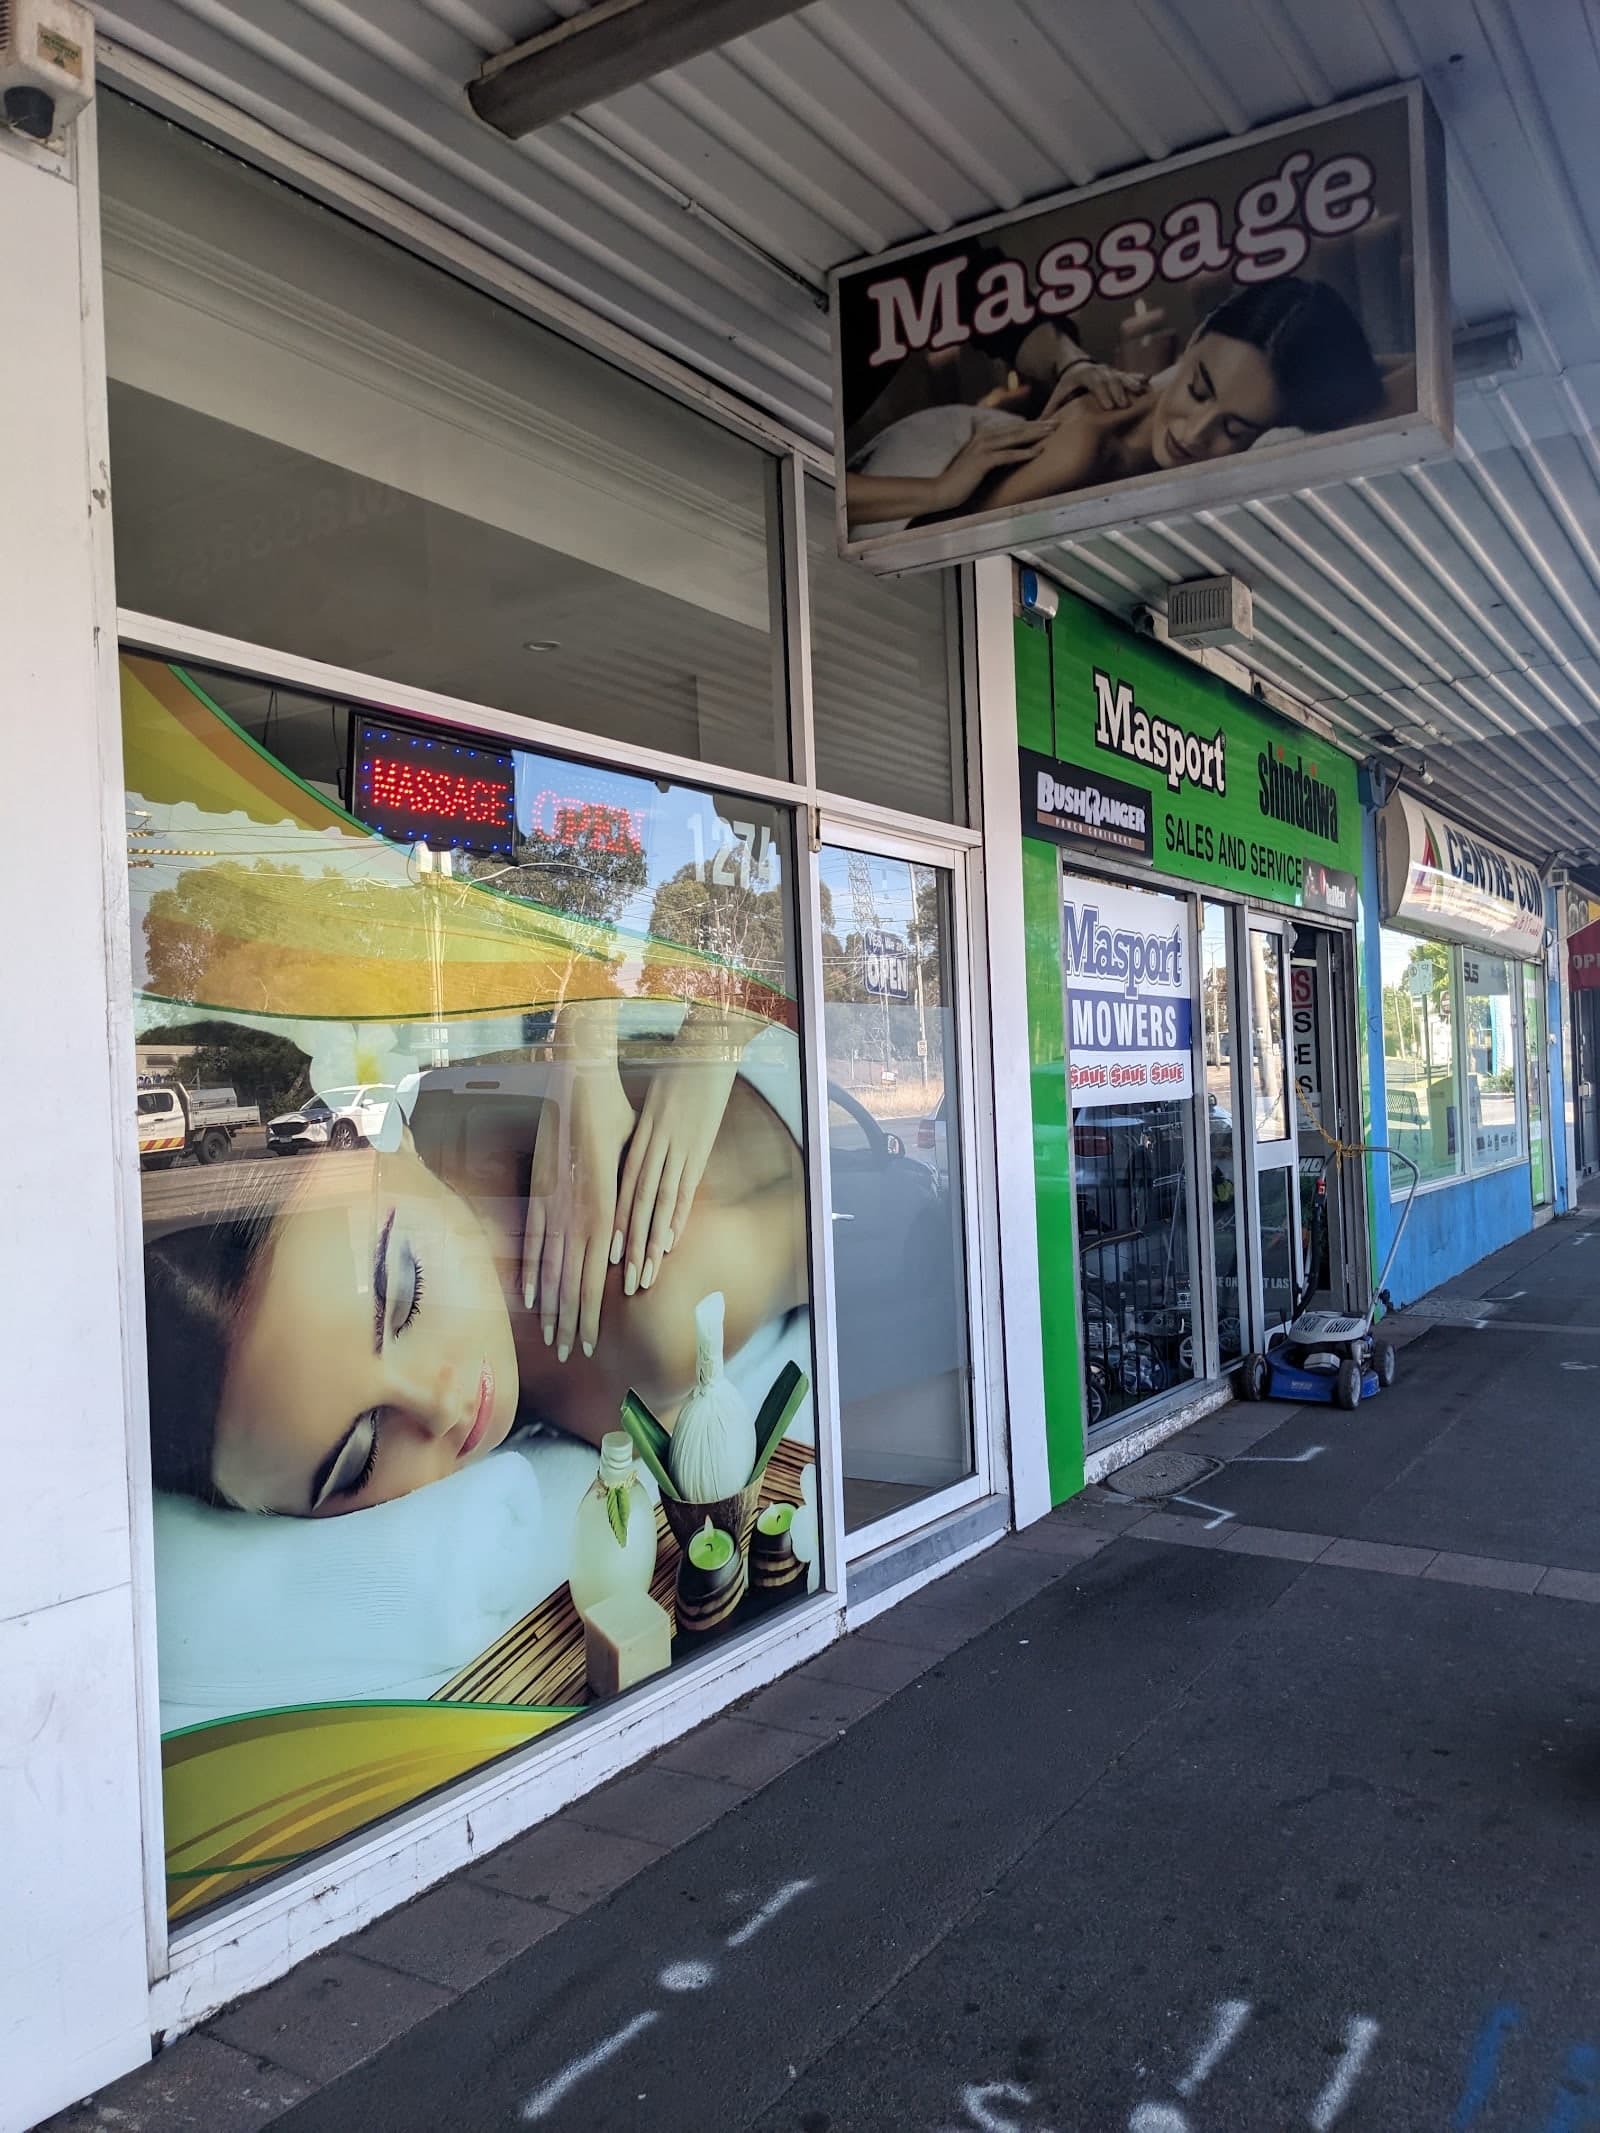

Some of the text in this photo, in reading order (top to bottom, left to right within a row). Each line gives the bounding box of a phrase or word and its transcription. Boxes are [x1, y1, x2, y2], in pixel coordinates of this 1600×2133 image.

[867, 150, 1375, 367] Massage
[1093, 668, 1226, 796] Masport
[373, 759, 507, 826] MASSAGE
[532, 789, 646, 855] OPEN
[1258, 740, 1339, 843] shindaiwa
[1165, 813, 1302, 888] SALES AND SERVICE
[1443, 823, 1515, 902] CENTRE
[868, 954, 908, 992] OPEN
[1064, 901, 1182, 1000] Masport
[1072, 1000, 1177, 1048] MOWERS
